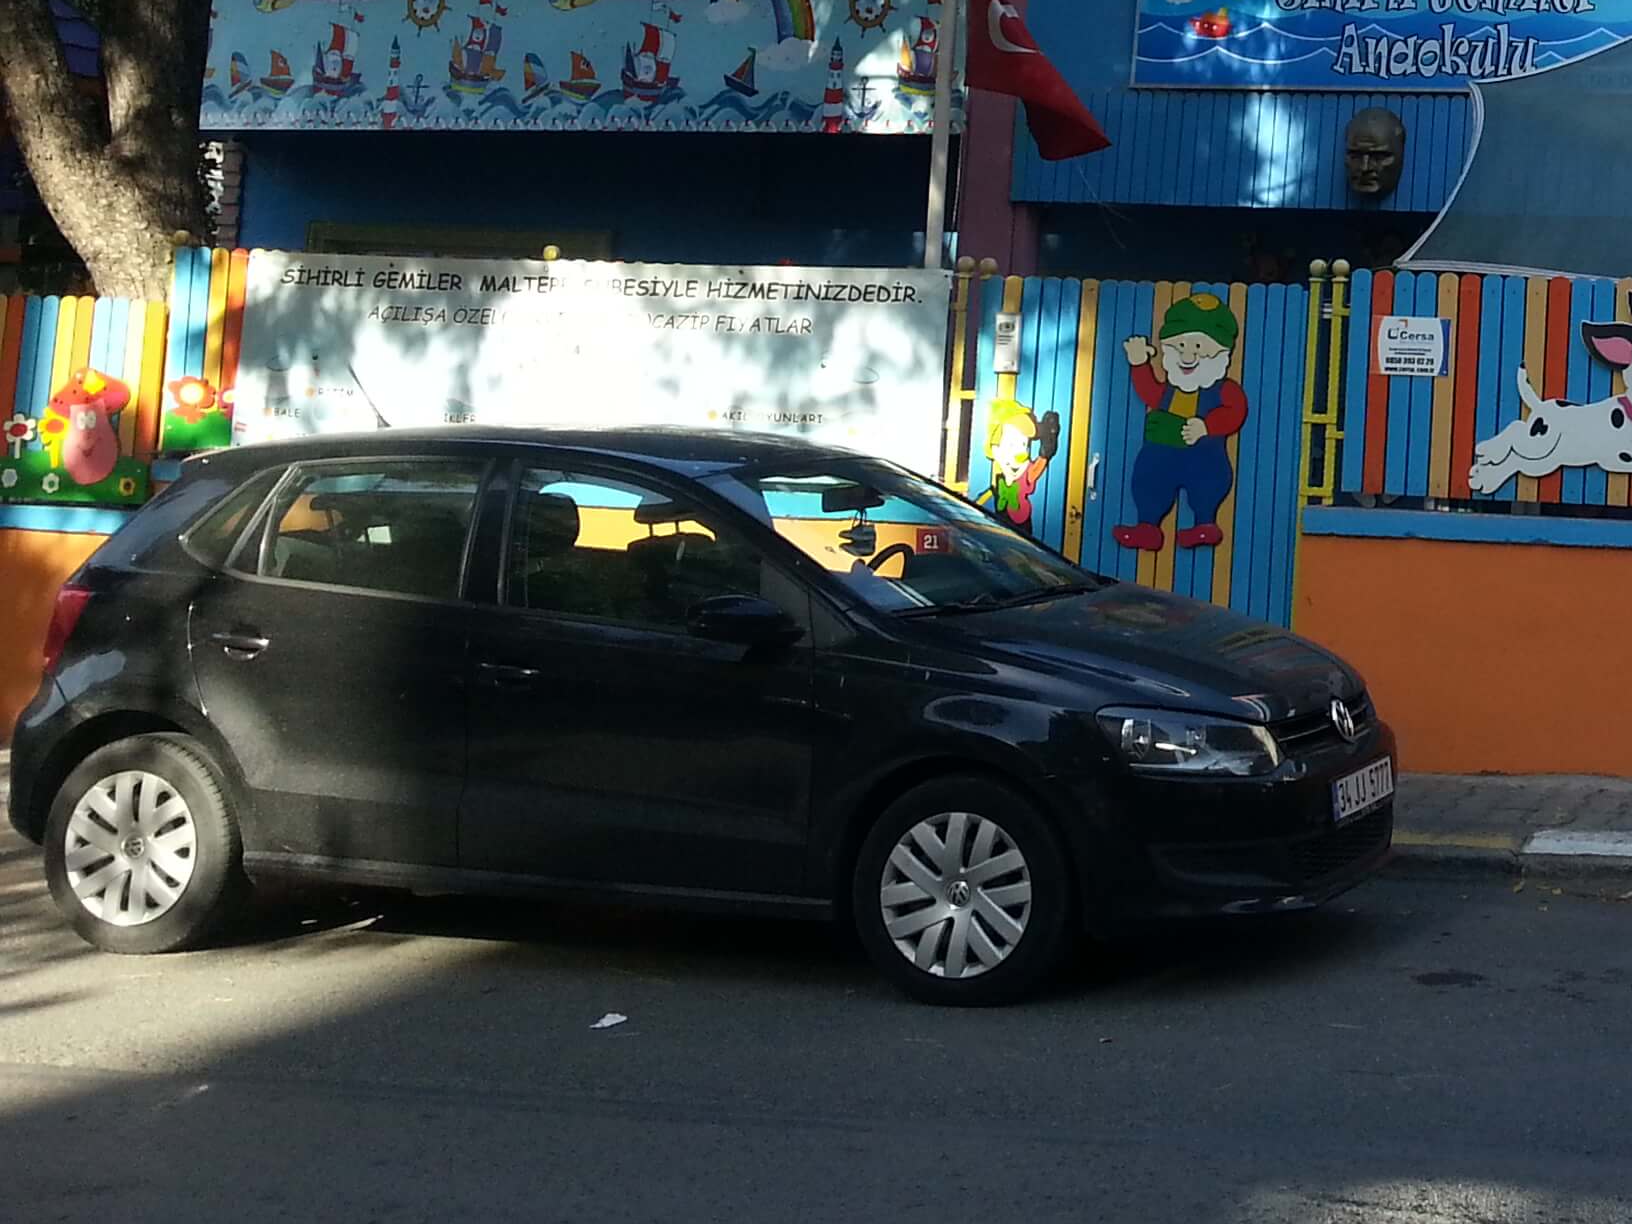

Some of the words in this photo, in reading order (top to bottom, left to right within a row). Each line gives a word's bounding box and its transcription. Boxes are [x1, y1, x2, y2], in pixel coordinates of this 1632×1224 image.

[1333, 22, 1540, 79] Anaokulu
[280, 266, 365, 287] SİHİRLİ
[372, 268, 462, 291] GEMİLER
[706, 277, 923, 304] HİZMETİNİZDEDİR.
[368, 305, 447, 325] AÇILIŞA
[923, 534, 939, 549] 21
[1338, 781, 1352, 812] 34
[1355, 773, 1367, 805] JJ
